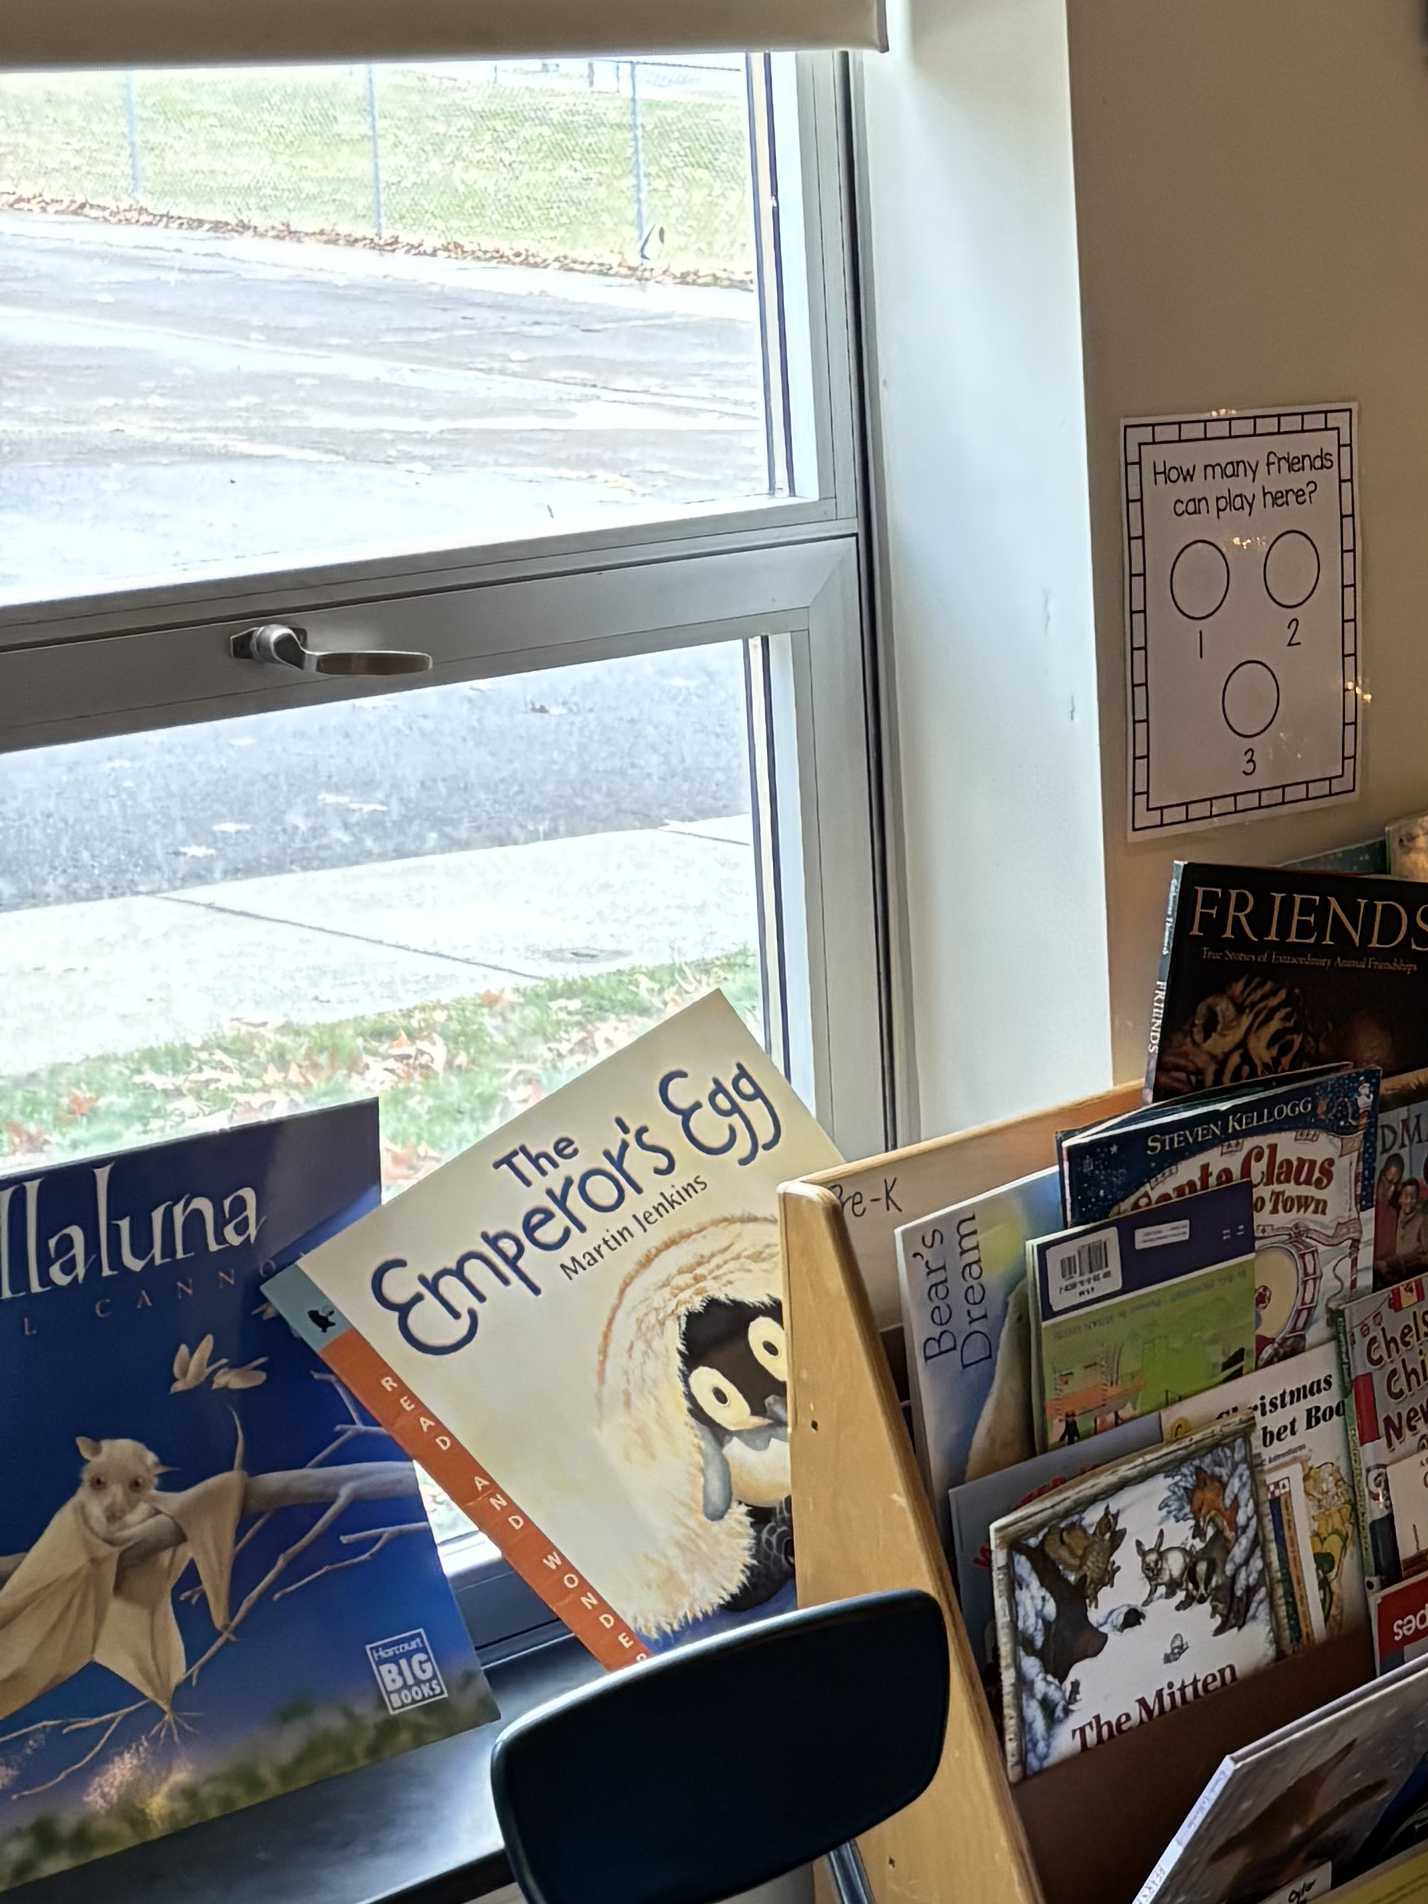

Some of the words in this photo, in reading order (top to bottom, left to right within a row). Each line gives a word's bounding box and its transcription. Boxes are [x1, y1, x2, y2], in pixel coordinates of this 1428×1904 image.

[1153, 460, 1196, 486] How
[1203, 459, 1259, 484] many
[1266, 449, 1334, 474] friends
[1173, 495, 1209, 518] can
[1216, 490, 1256, 522] play
[1263, 481, 1318, 507] here?
[1198, 630, 1203, 659] 1
[1286, 618, 1301, 647] 2
[1242, 748, 1257, 776] 3
[1146, 1120, 1222, 1156] STEVEN
[1228, 1098, 1312, 1130] KELLOGG
[492, 1136, 579, 1188] The
[1240, 1144, 1334, 1190] Claus
[371, 1117, 675, 1356] Emperor's
[658, 1062, 781, 1167] Egg
[559, 1223, 635, 1281] Martin
[636, 1174, 708, 1233] Jenkins
[912, 1228, 957, 1363] Bear's
[956, 1213, 992, 1370] Dream
[381, 1376, 451, 1450] READ
[474, 1476, 524, 1530] AND
[379, 1652, 433, 1693] BIG
[389, 1680, 441, 1709] BOOKS
[1072, 1712, 1133, 1754] The
[1134, 1662, 1240, 1728] Mitten
